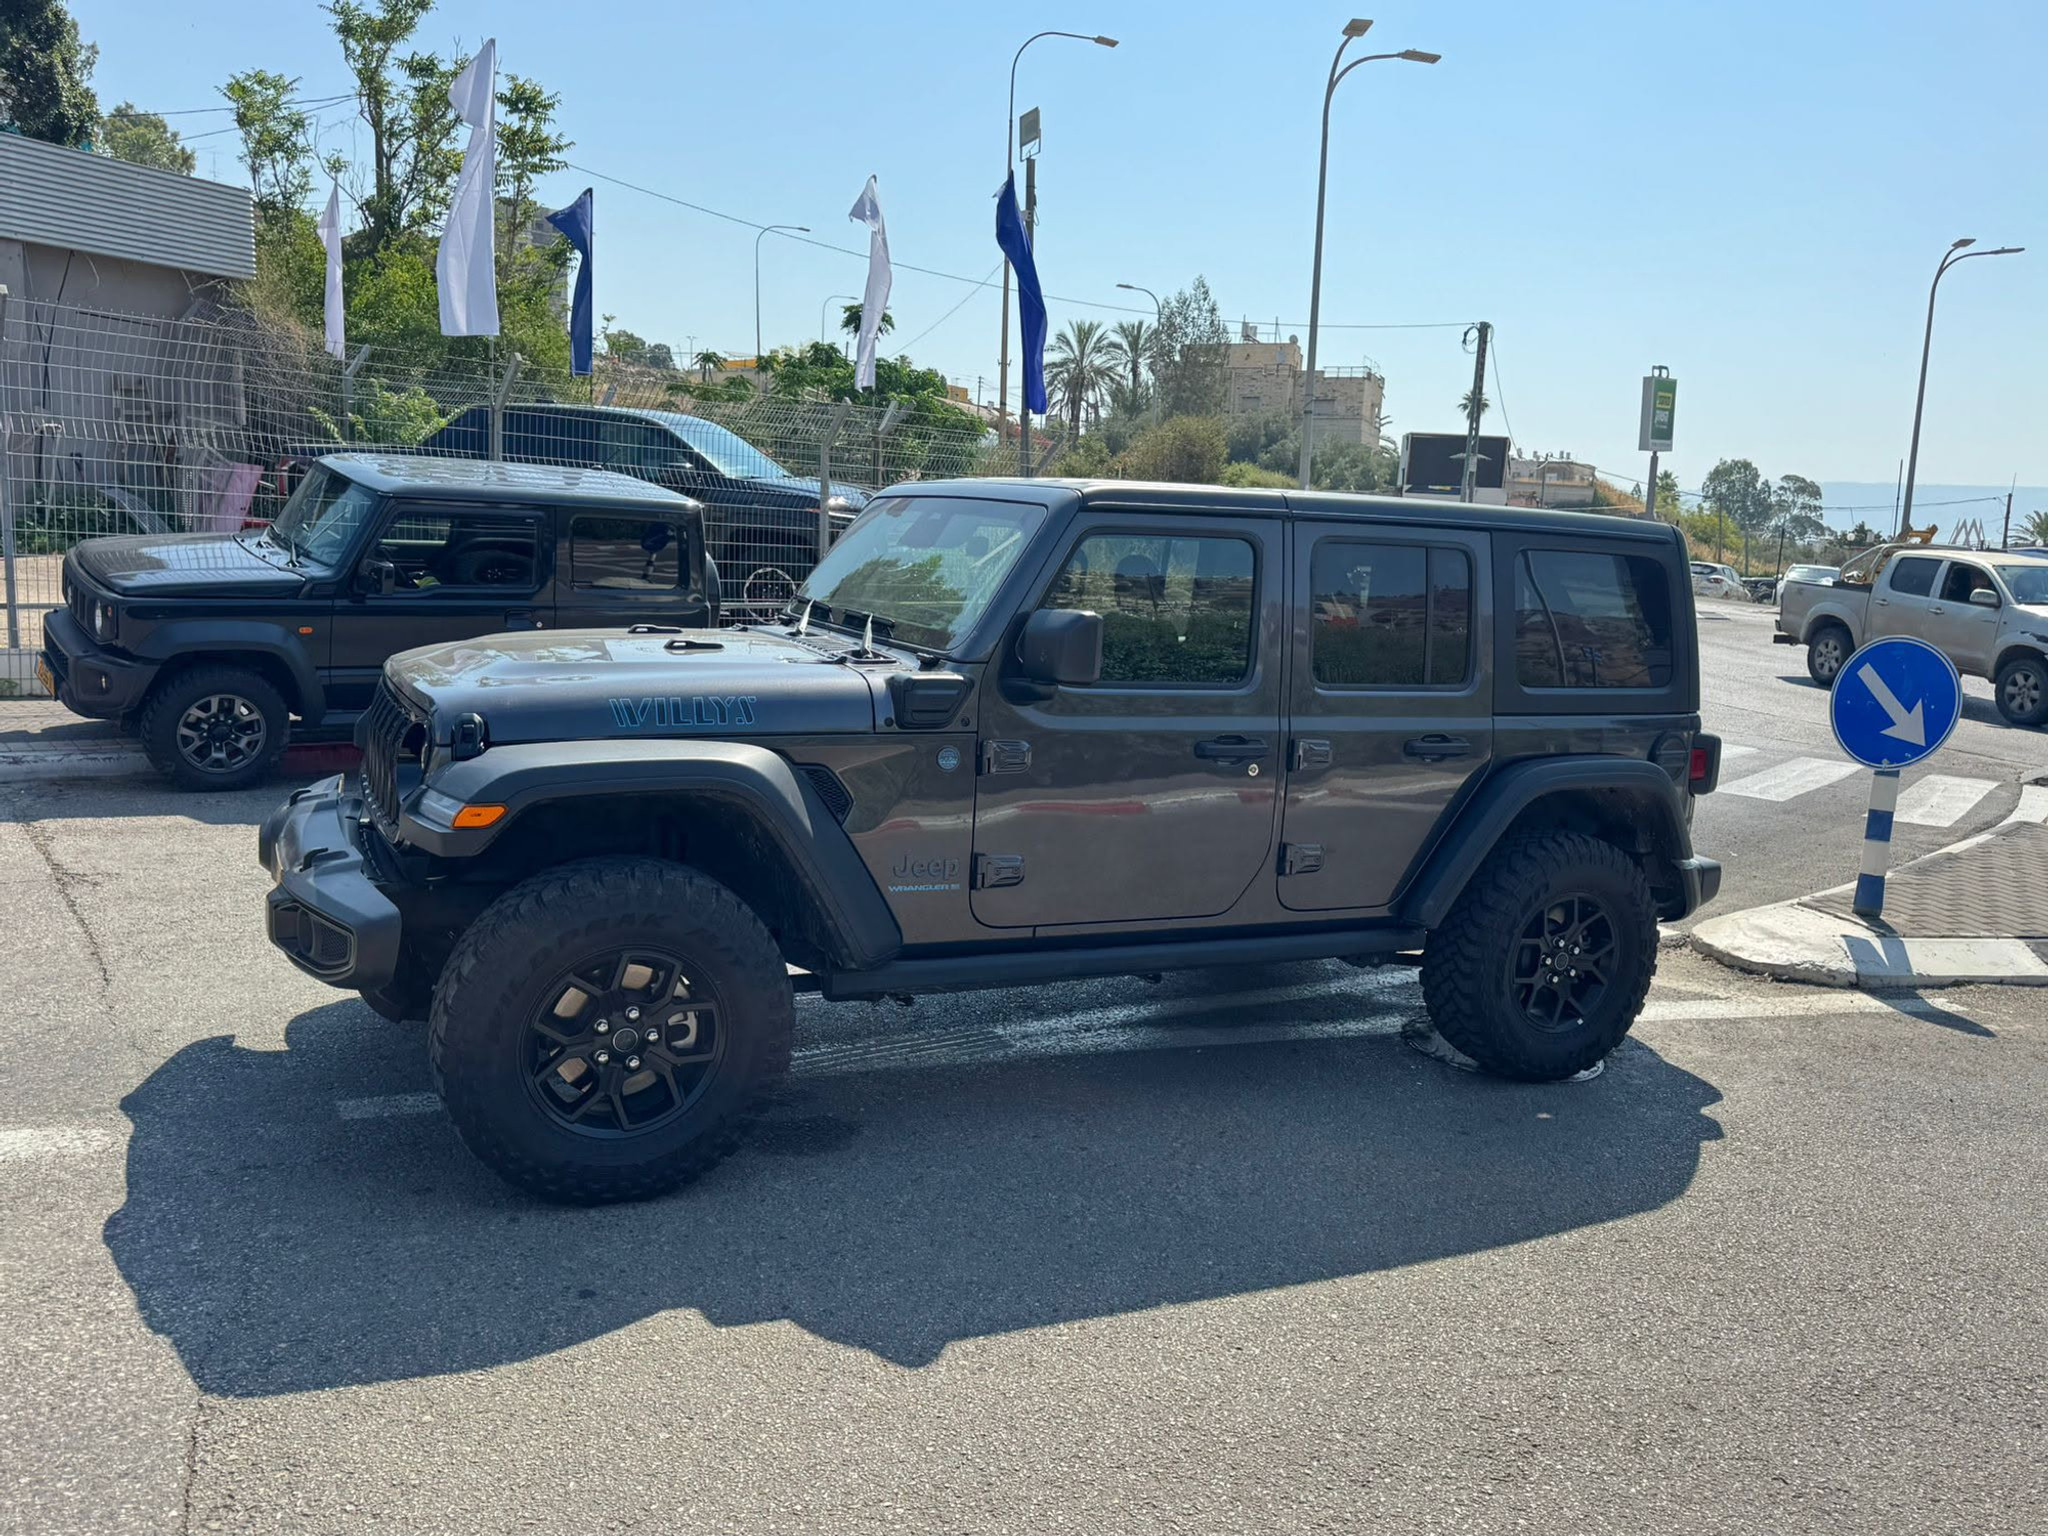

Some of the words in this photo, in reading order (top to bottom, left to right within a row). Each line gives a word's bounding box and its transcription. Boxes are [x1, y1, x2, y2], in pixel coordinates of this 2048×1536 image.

[609, 696, 757, 727] WILLYS
[892, 852, 960, 881] Jeep
[888, 884, 949, 892] WRANGLER
